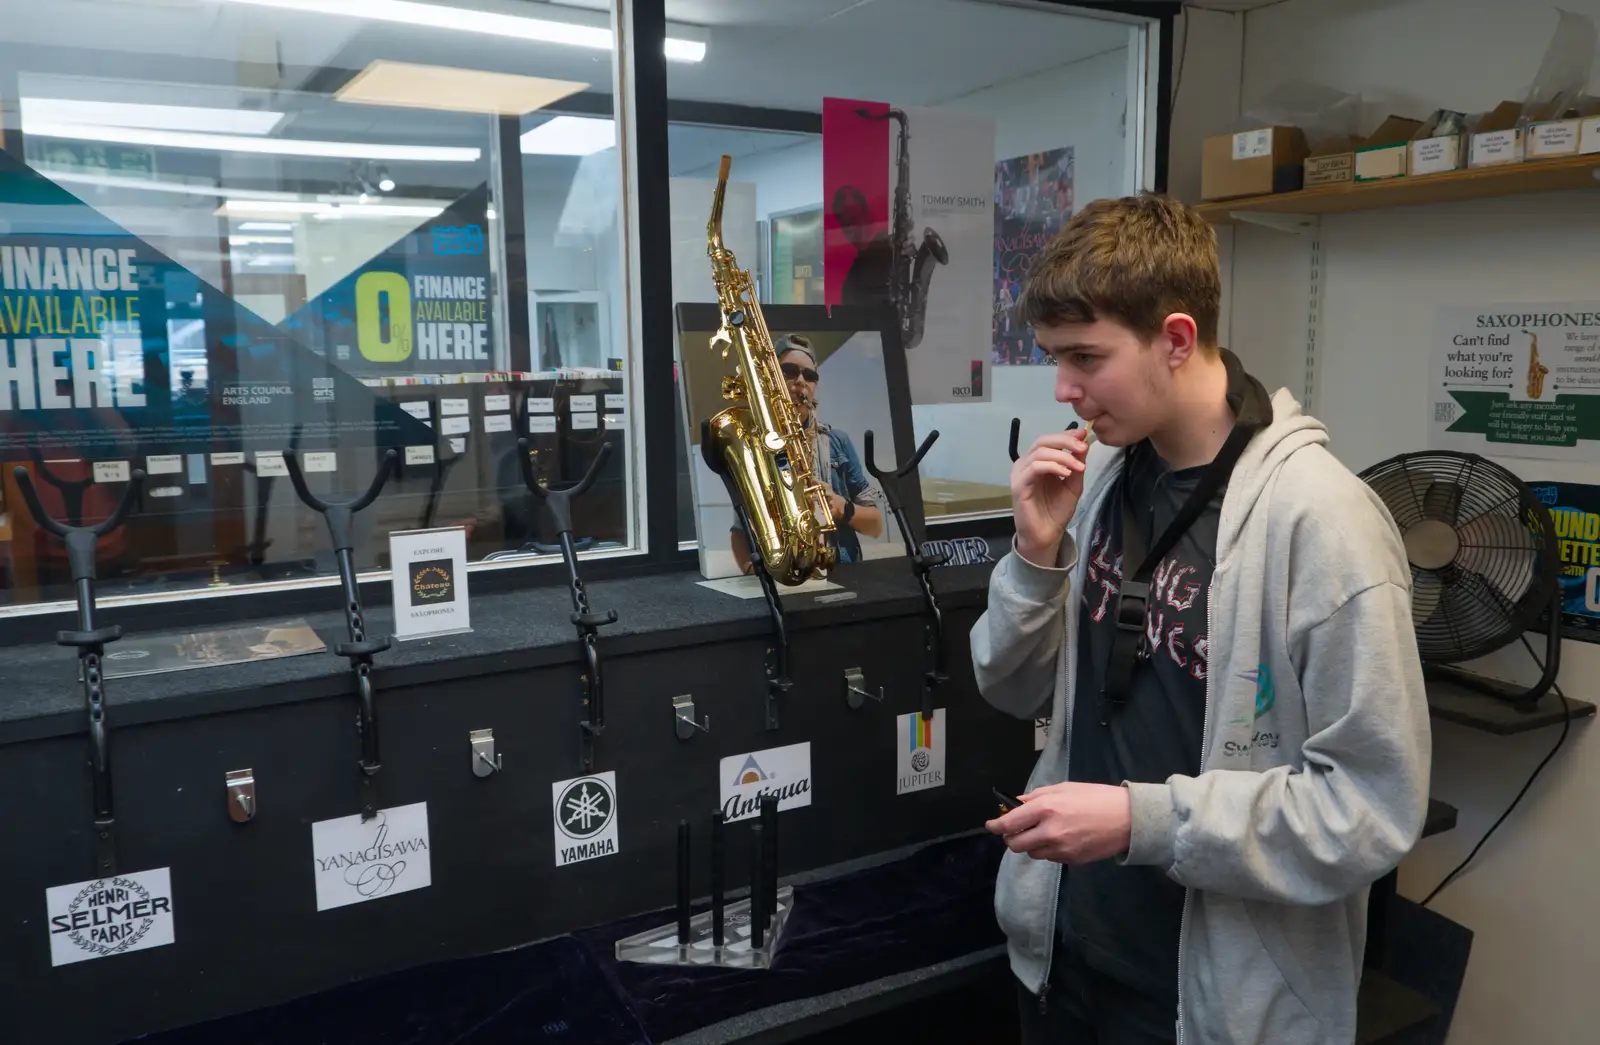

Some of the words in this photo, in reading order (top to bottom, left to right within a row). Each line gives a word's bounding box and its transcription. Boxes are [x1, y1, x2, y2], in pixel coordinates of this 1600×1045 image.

[922, 195, 955, 206] TOMMY
[957, 196, 986, 207] SMITH
[0, 245, 139, 291] INANCE
[414, 275, 486, 300] FINANCE
[416, 301, 487, 321] AVAILABLE
[1476, 312, 1600, 328] SAXOPHONES
[416, 323, 489, 360] HERE
[1453, 334, 1484, 346] Can't
[1487, 333, 1510, 346] find
[1565, 332, 1578, 341] We
[1447, 350, 1476, 362] what
[1478, 352, 1514, 365] you're
[0, 338, 147, 411] HERE
[1444, 366, 1489, 381] looking
[1492, 366, 1514, 379] for?
[222, 386, 249, 396] ARTS
[251, 385, 293, 395] COUNCIL
[313, 388, 335, 397] arts
[952, 387, 971, 397] RICO
[222, 396, 271, 405] ENGLAND
[1505, 401, 1518, 409] ask
[1566, 403, 1576, 411] of
[1502, 410, 1530, 422] friendly
[1530, 412, 1548, 421] staff
[1549, 413, 1564, 421] and
[1511, 421, 1534, 432] happy
[1545, 422, 1561, 434] help
[1563, 425, 1578, 434] you
[1530, 434, 1544, 442] you
[413, 547, 444, 555] EXPLORE
[414, 581, 450, 590] Chateau
[410, 608, 455, 618] SAXOPHONES
[899, 771, 943, 792] JUPITER
[316, 838, 428, 872] YANAGISAWA
[561, 838, 615, 863] YAMAHA
[88, 888, 130, 908] HENRI
[51, 896, 171, 934] SELMER
[91, 922, 134, 943] PARIS
